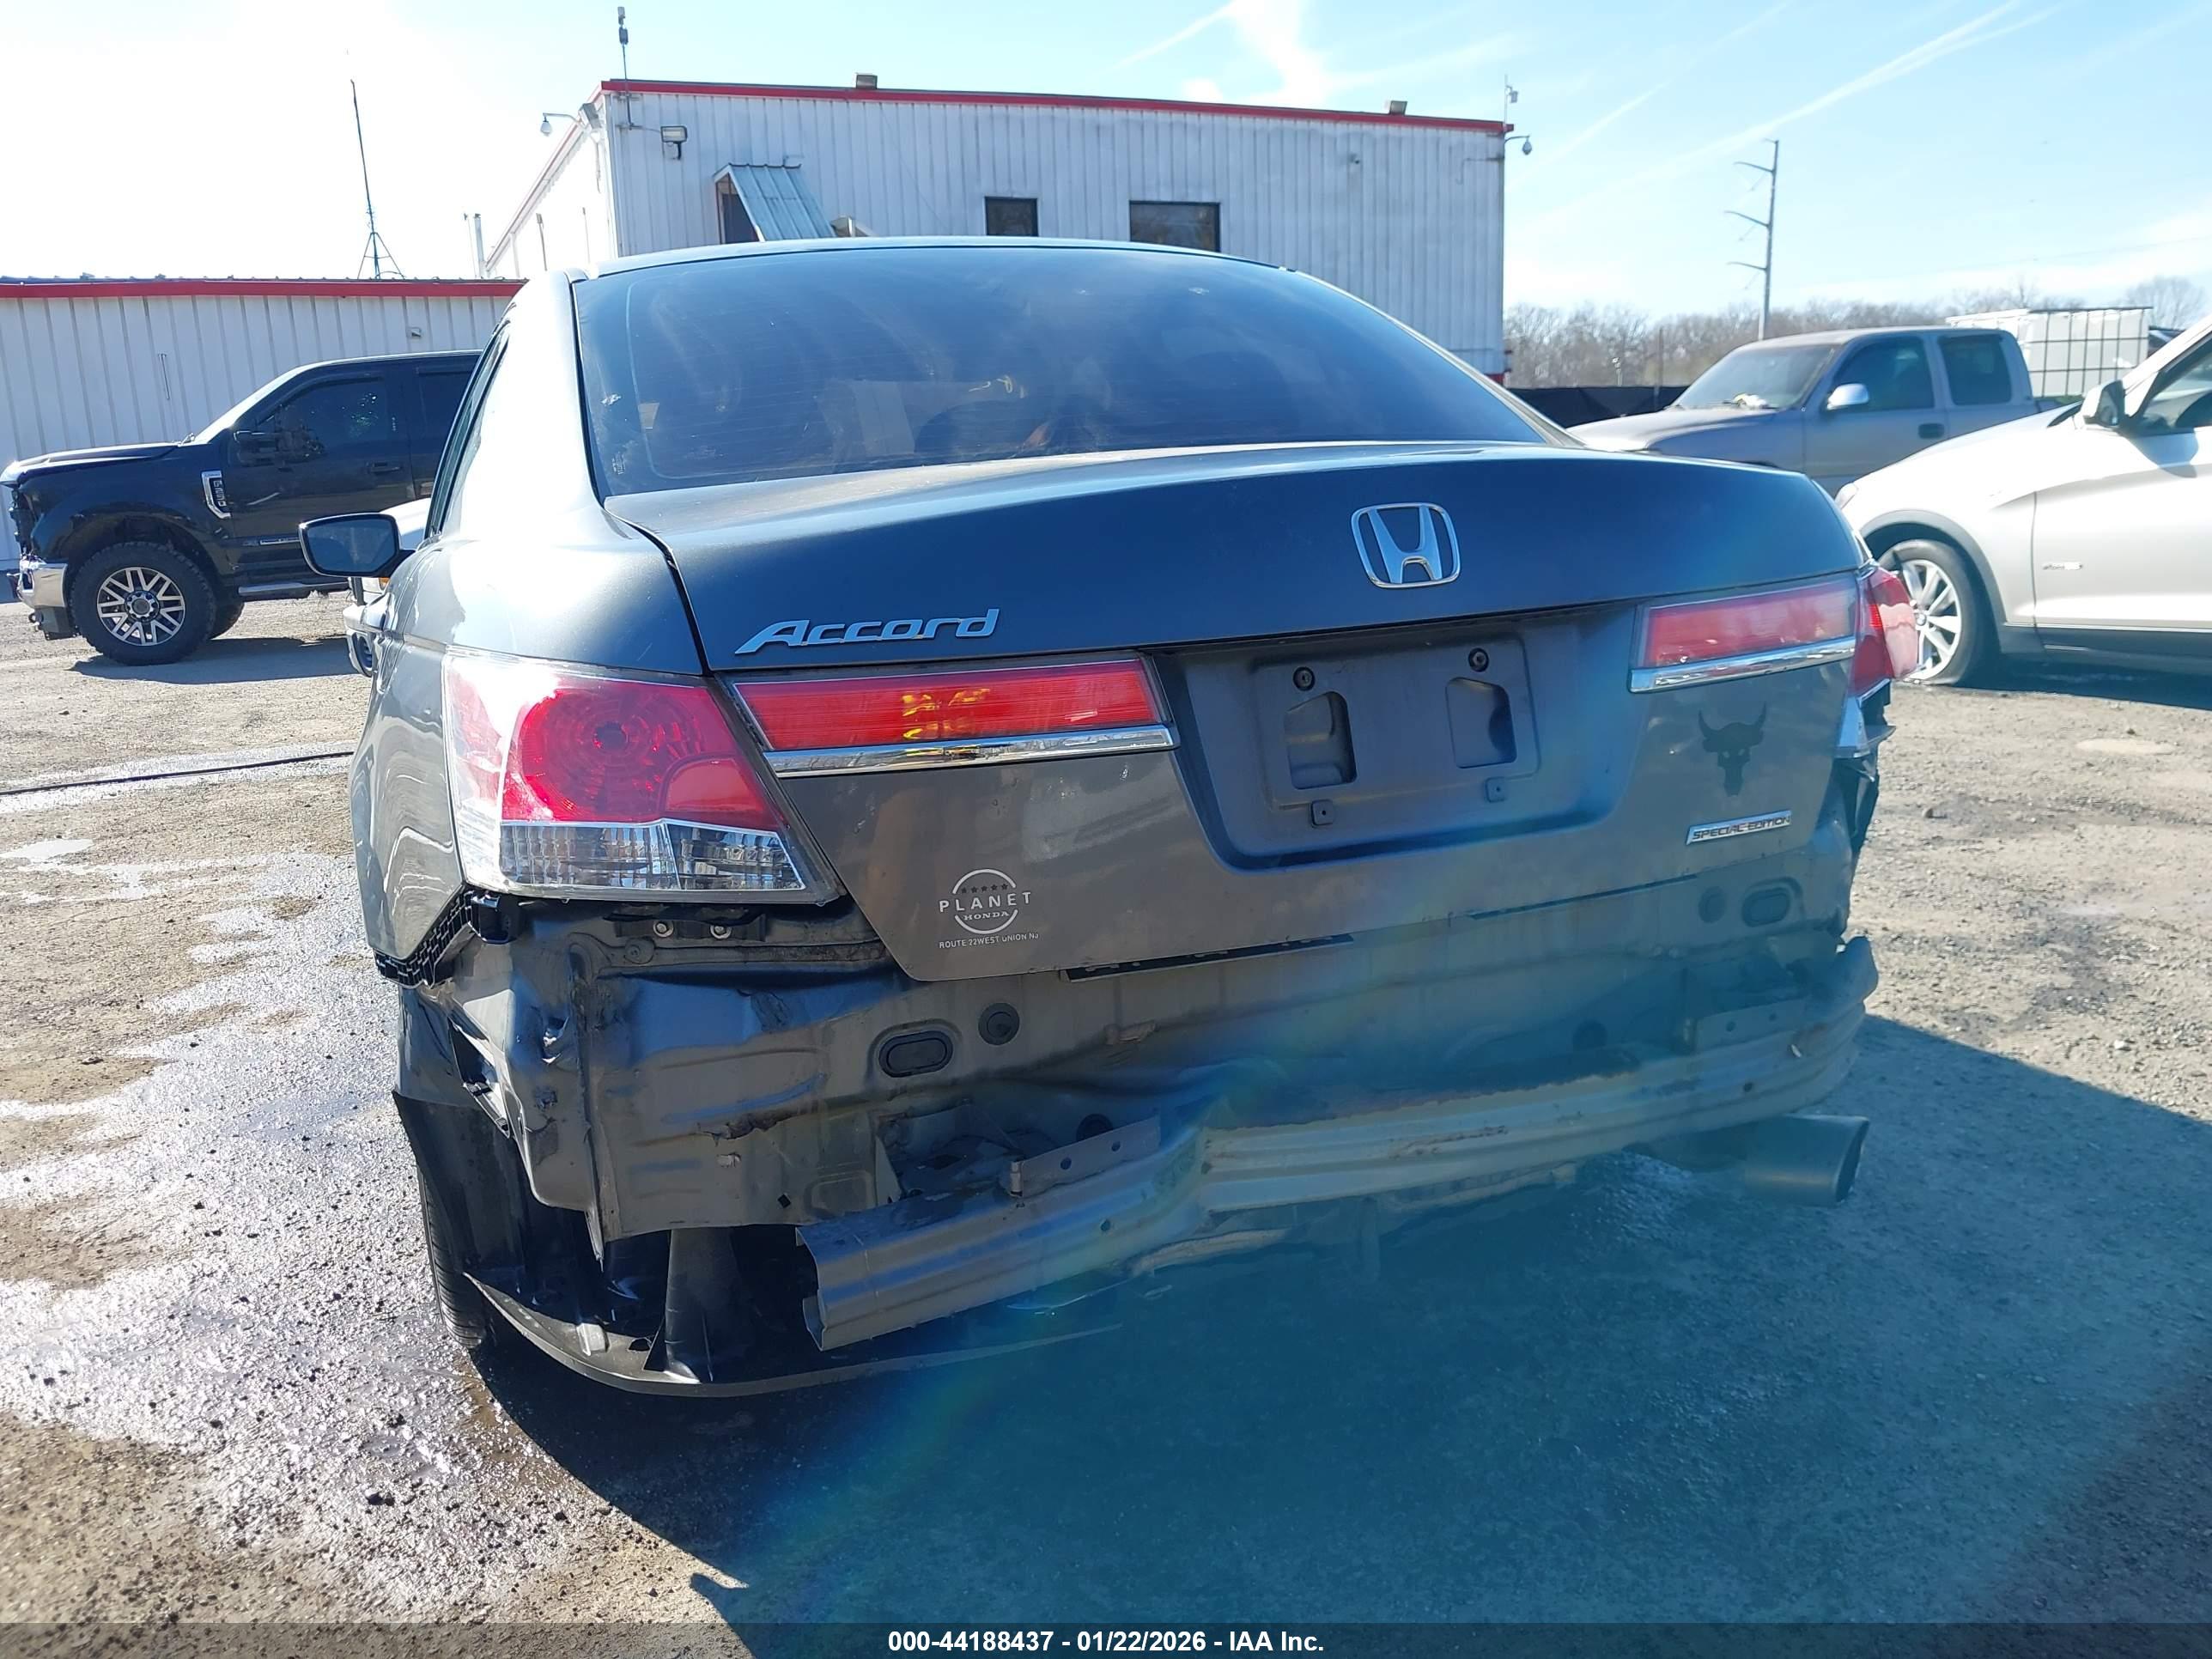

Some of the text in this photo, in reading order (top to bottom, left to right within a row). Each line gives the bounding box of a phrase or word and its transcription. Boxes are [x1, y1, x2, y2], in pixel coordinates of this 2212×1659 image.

[734, 609, 1000, 654] Accord
[1692, 816, 1790, 840] SPECIAL EDITION
[939, 891, 1031, 913] PLANET
[963, 910, 1010, 921] HONDA
[939, 939, 967, 949] ROUTE
[1001, 933, 1027, 942] UNION
